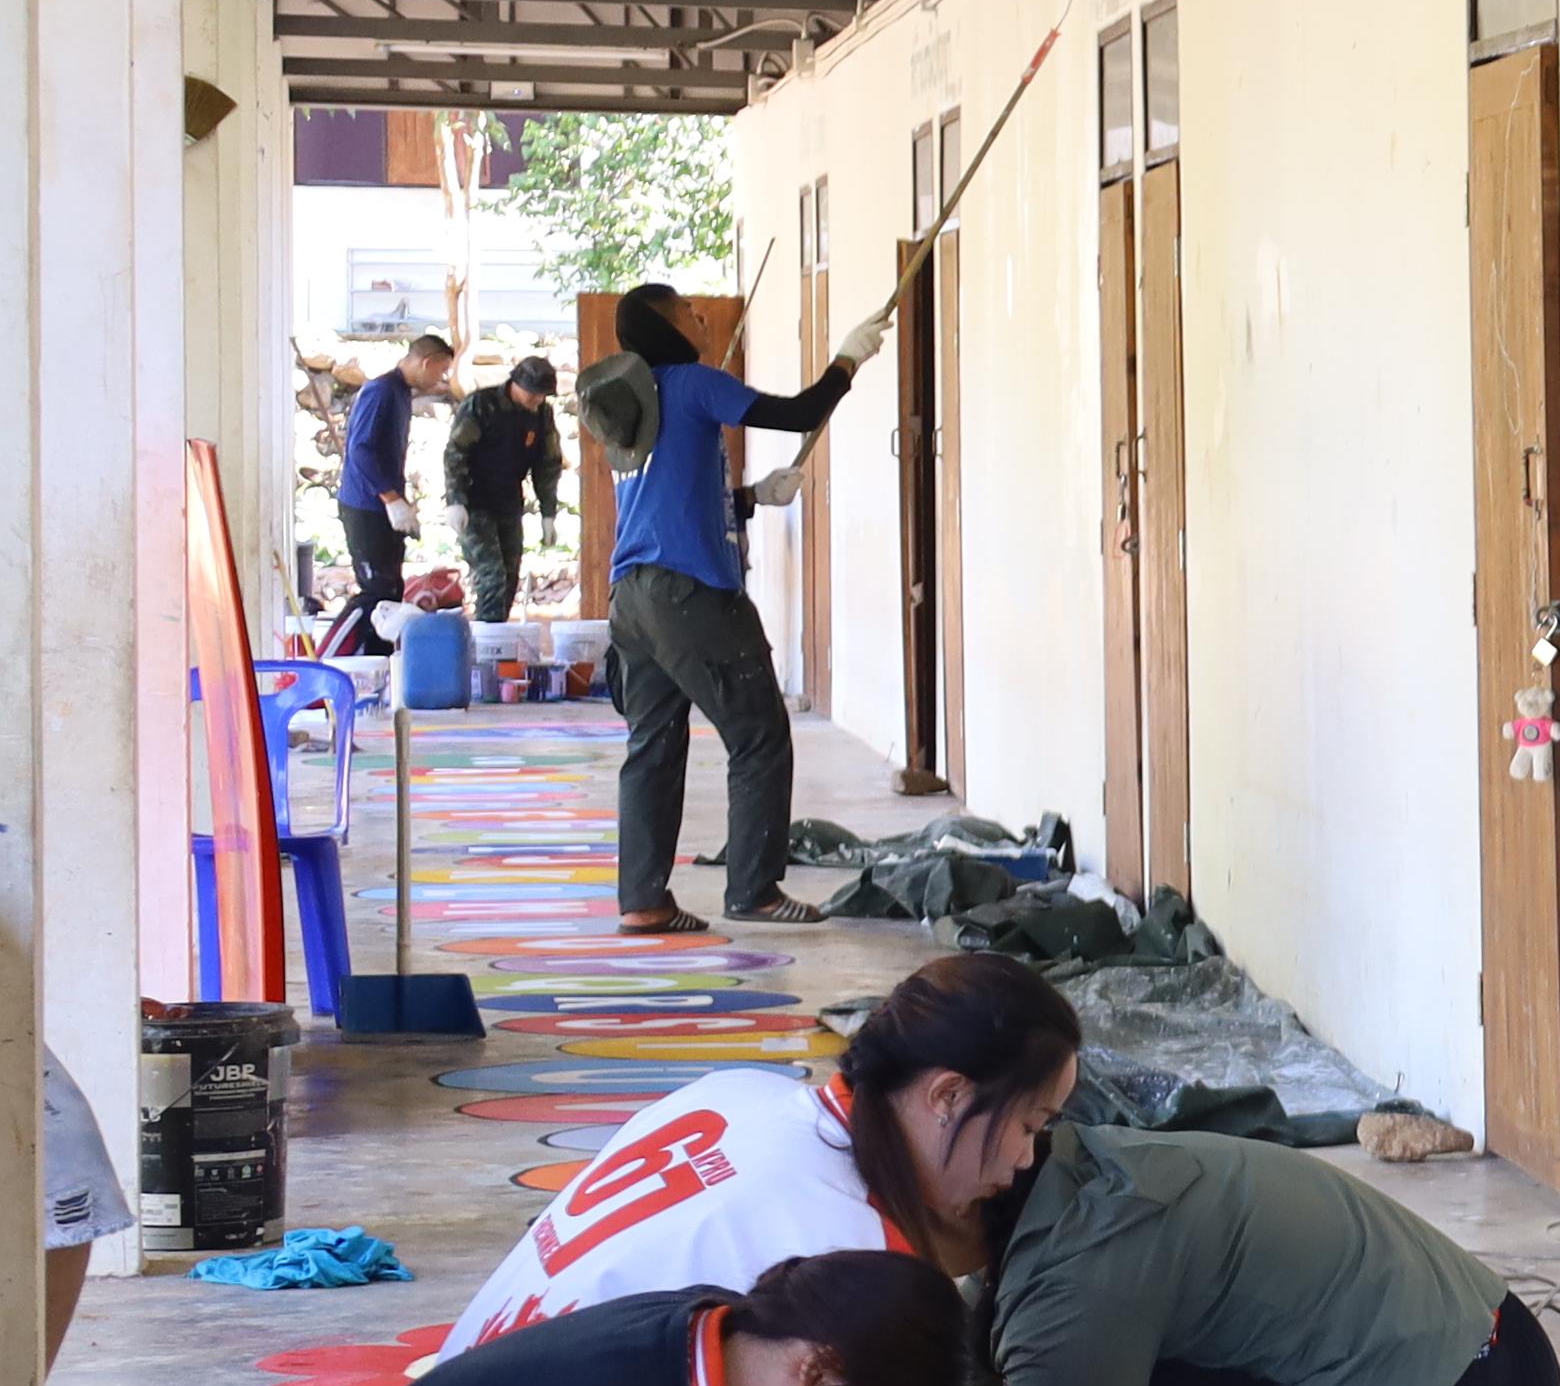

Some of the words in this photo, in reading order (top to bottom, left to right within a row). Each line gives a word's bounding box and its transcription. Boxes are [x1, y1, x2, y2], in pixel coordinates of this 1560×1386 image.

[553, 995, 714, 1011] R
[555, 1017, 757, 1030] S
[544, 1109, 729, 1279] 67
